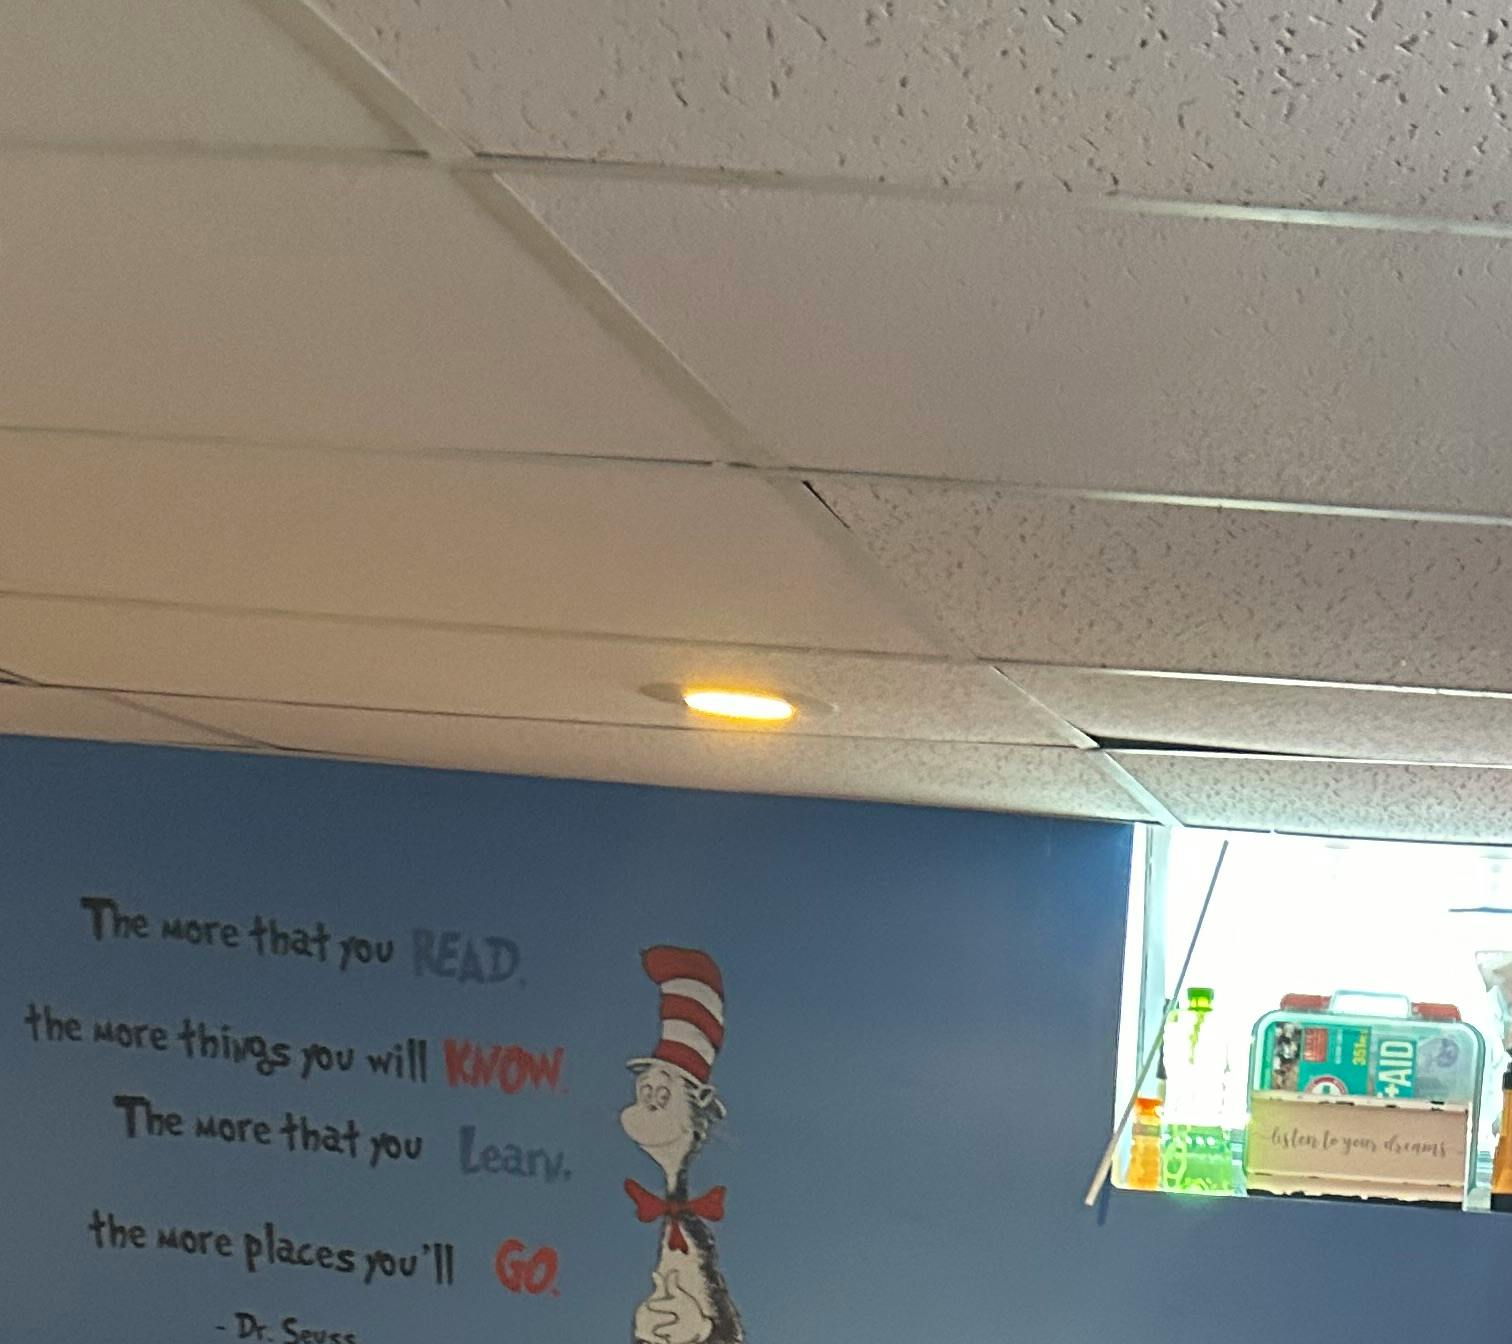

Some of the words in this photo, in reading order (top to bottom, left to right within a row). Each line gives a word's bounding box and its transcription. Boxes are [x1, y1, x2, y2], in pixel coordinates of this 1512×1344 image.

[80, 896, 149, 941] The
[249, 914, 331, 962] that
[339, 935, 394, 971] you
[24, 1003, 82, 1041] the
[178, 1018, 290, 1076] things
[301, 1043, 354, 1080] you
[367, 1037, 428, 1083] will
[113, 1095, 183, 1138] The
[281, 1112, 360, 1158] that
[370, 1132, 423, 1168] you
[88, 1208, 147, 1248] the
[244, 1221, 356, 1273] places
[364, 1243, 454, 1286] you'll
[234, 1312, 275, 1342] Dr.
